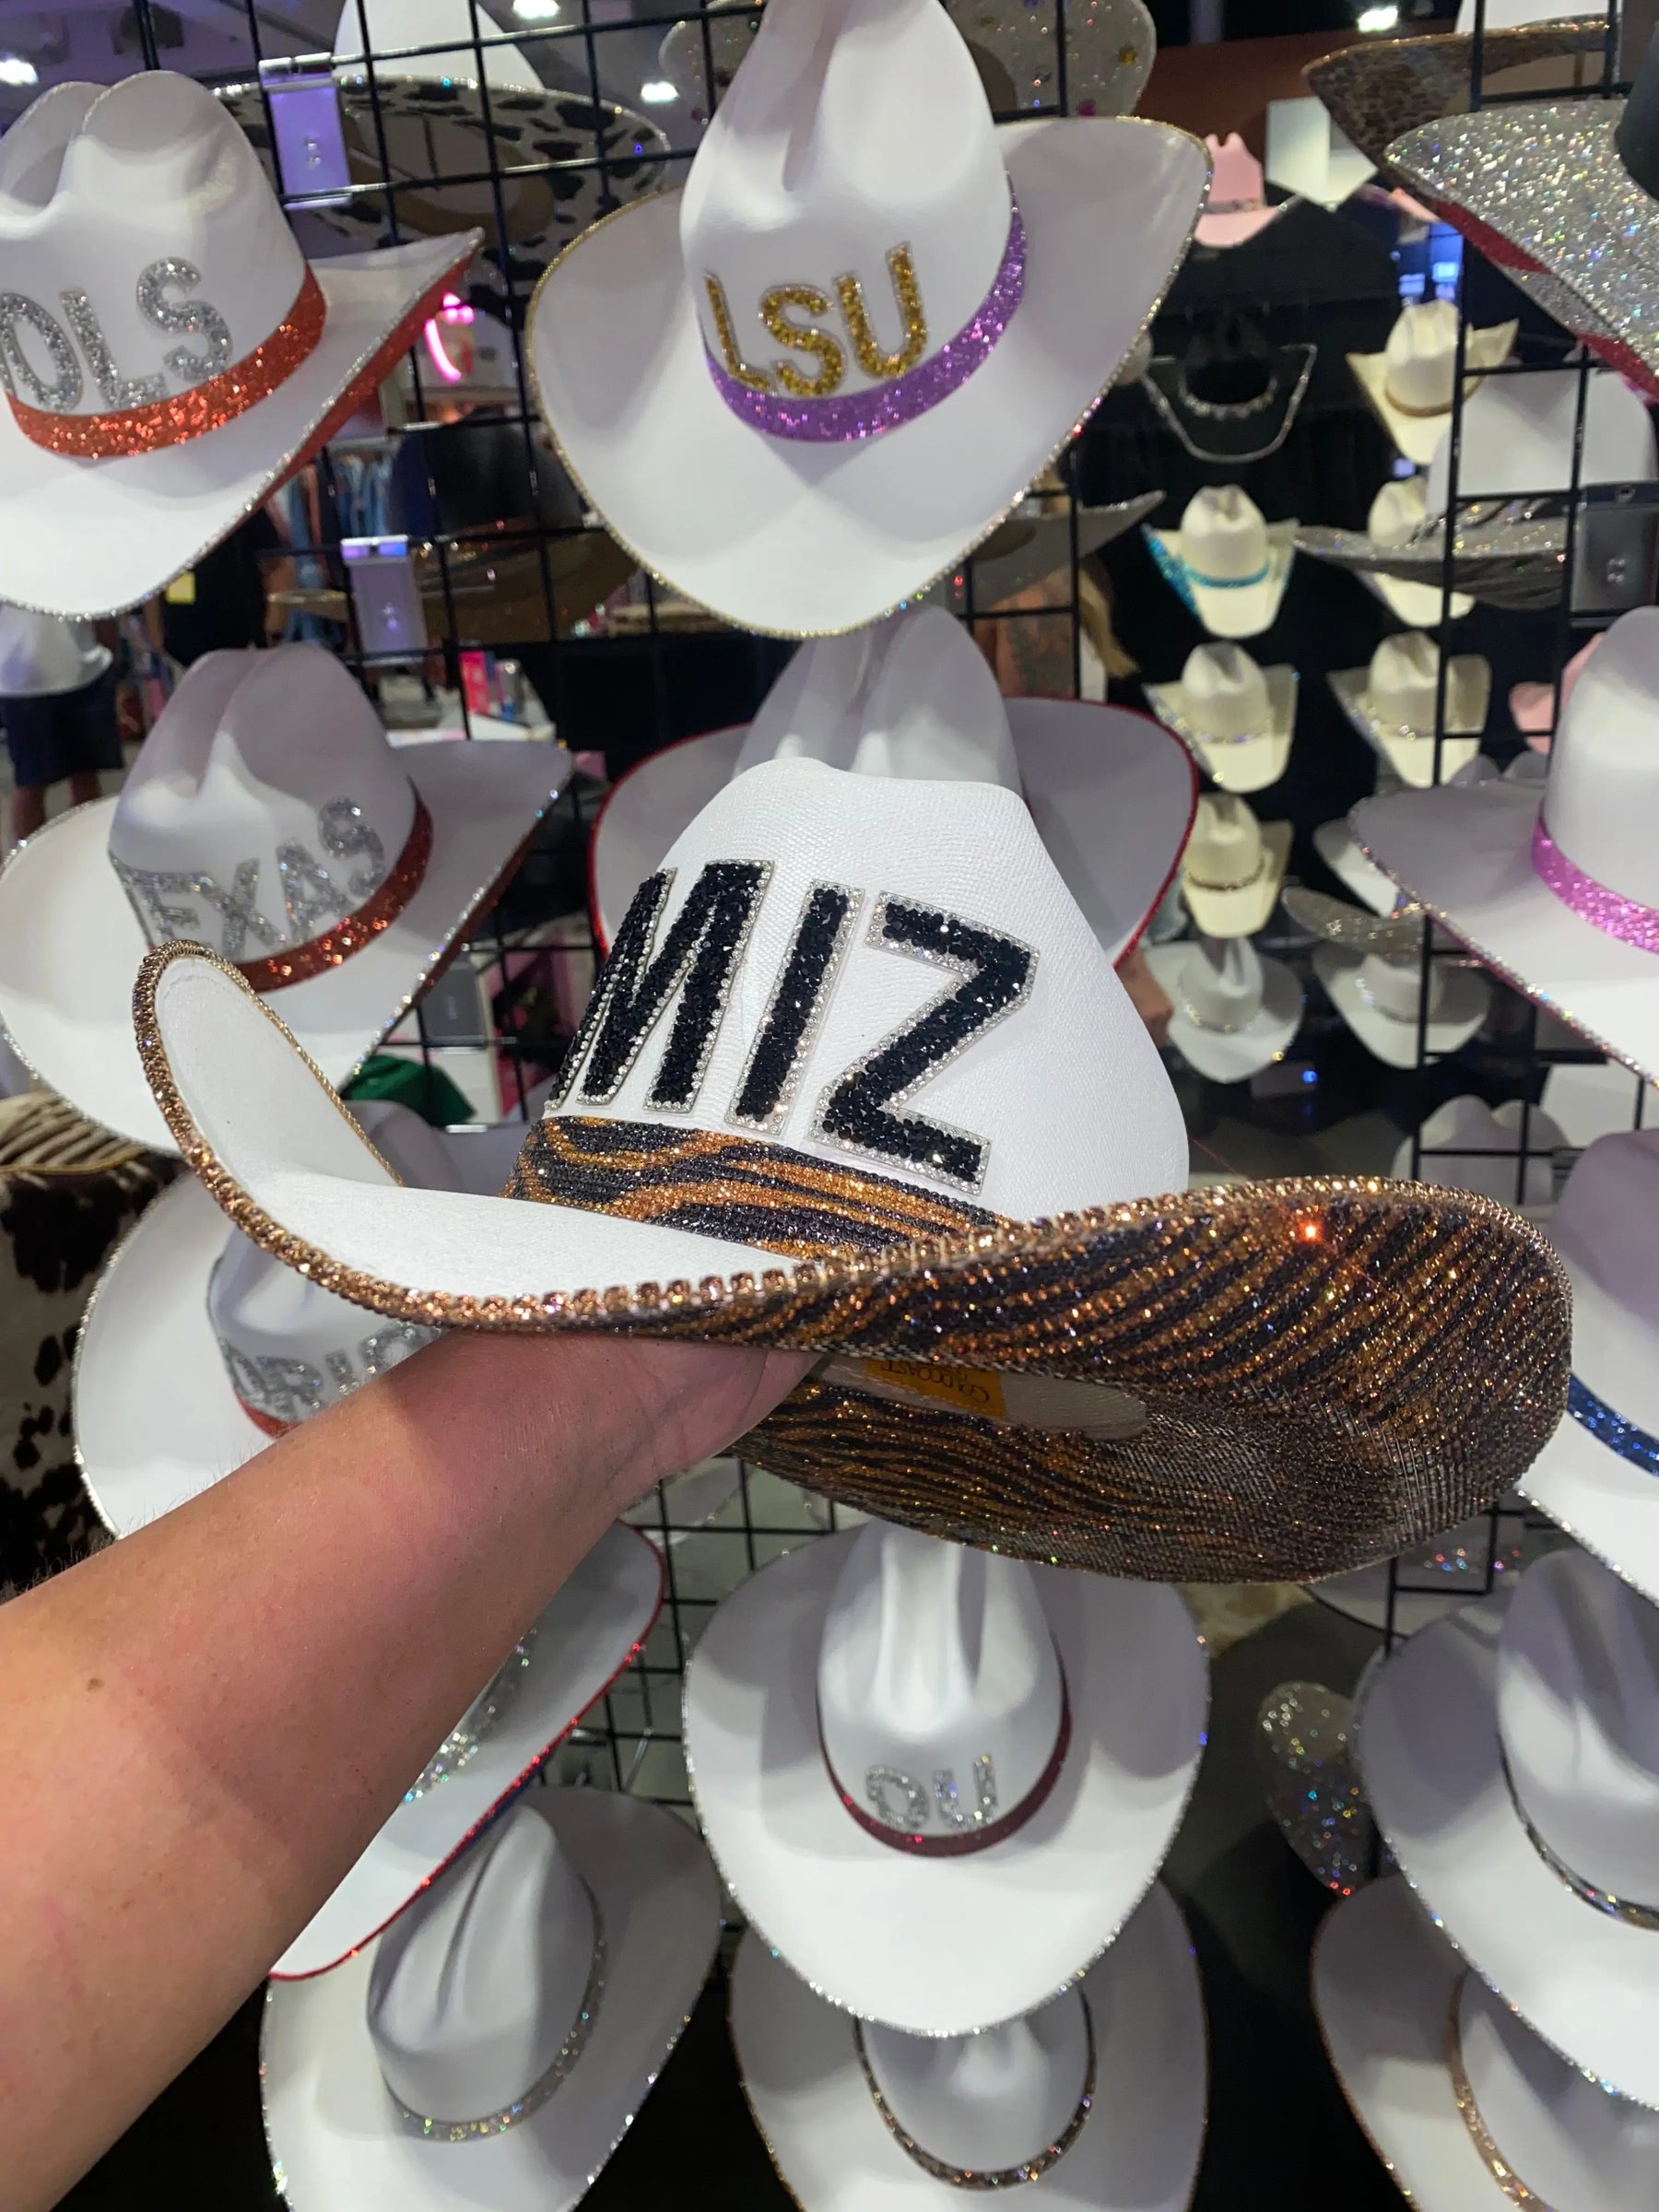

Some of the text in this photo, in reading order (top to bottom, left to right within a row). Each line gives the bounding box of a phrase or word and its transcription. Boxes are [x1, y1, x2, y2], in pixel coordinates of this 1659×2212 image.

[0, 255, 233, 412] OLS
[701, 241, 928, 396] LSU
[544, 859, 1040, 1196] MIZ
[865, 1752, 998, 1831] OU
